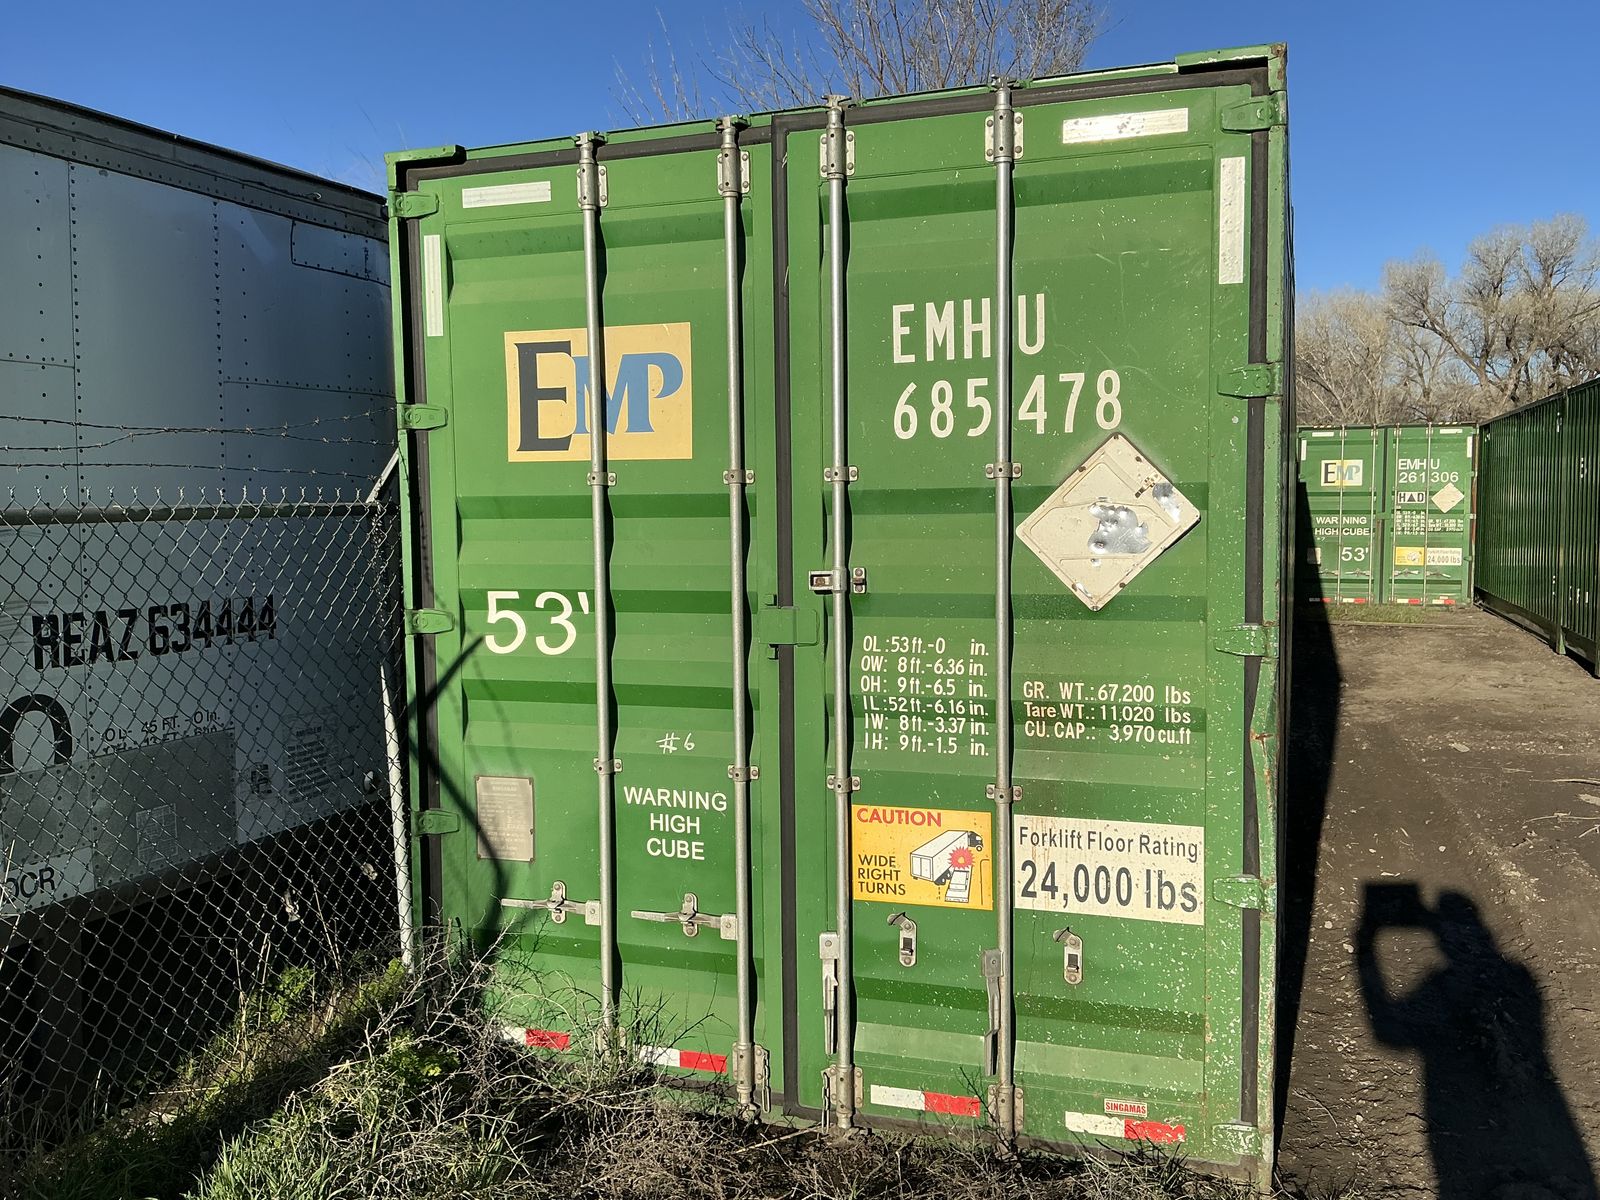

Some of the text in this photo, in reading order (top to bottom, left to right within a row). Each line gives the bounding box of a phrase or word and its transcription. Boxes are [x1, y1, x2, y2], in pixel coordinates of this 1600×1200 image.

[892, 293, 1045, 363] EMHU
[514, 340, 684, 451] EMP
[893, 369, 1122, 439] 685478
[1323, 462, 1361, 484] EMP
[1398, 459, 1440, 470] EMHU
[1399, 471, 1459, 483] 261306
[1314, 527, 1369, 536] HIGH CUBE
[1316, 516, 1367, 525] WARNING
[1341, 547, 1369, 562] 53'
[32, 595, 277, 671] REAZ 634444
[485, 591, 590, 655] 53'
[970, 638, 989, 656] in.
[861, 655, 888, 673] OW:
[968, 659, 988, 677] in.
[860, 675, 888, 693] OH:
[968, 679, 988, 698] in.
[1023, 681, 1050, 699] GR.
[1165, 686, 1192, 705] lbs
[969, 700, 989, 716] in.
[1024, 701, 1057, 718] Tare
[1100, 705, 1155, 723] 11,020
[1165, 706, 1192, 724] lbs
[864, 713, 889, 731] IW:
[970, 718, 990, 736] in.
[1024, 721, 1050, 738] CU.
[1109, 725, 1155, 743] 3,970
[864, 732, 888, 750] IH:
[970, 738, 990, 756] in.
[623, 786, 728, 812] WARNING
[649, 813, 701, 835] HIGH
[856, 806, 942, 828] CAUTION
[646, 838, 705, 861] CUBE
[1019, 826, 1199, 864] Forklift Floor Rating
[858, 854, 897, 868] WIDE
[858, 868, 901, 882] RIGHT
[1020, 859, 1199, 913] 24,000 lbs
[858, 881, 907, 896] TURNS
[1105, 1101, 1146, 1114] SINGAMAS
